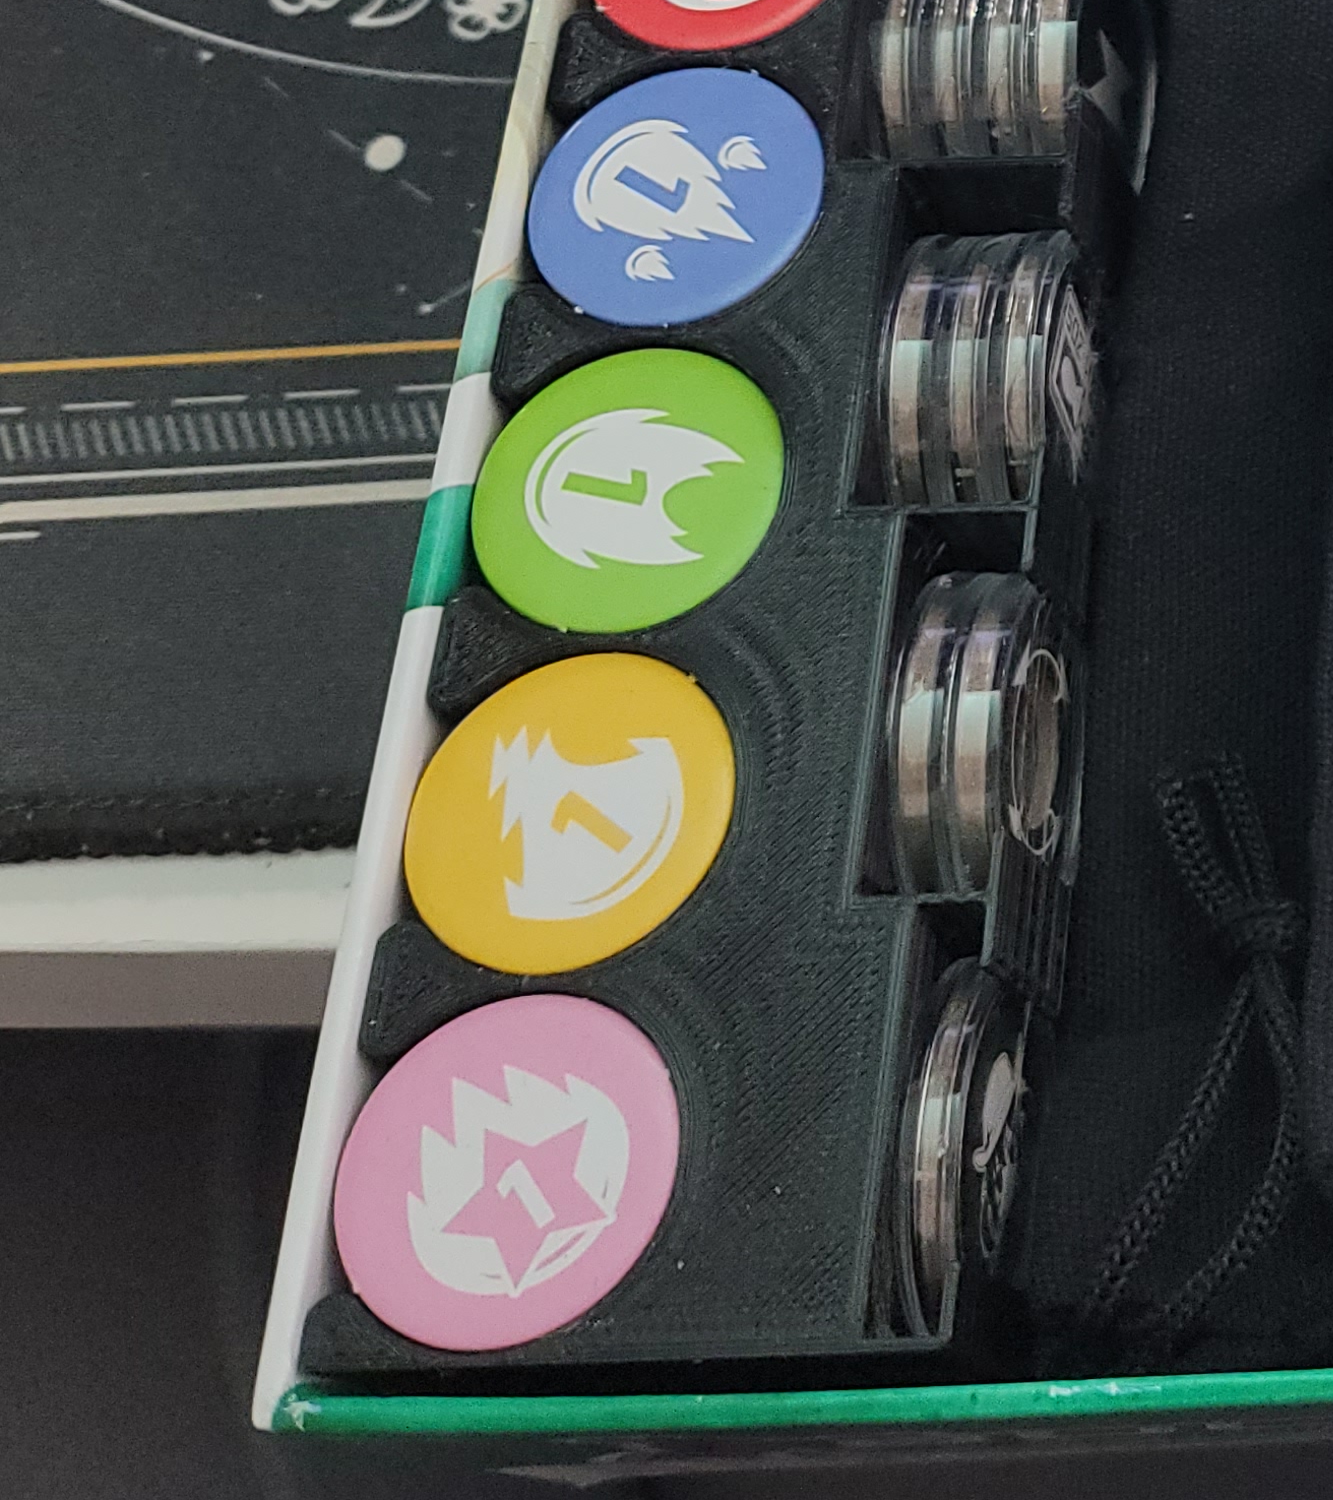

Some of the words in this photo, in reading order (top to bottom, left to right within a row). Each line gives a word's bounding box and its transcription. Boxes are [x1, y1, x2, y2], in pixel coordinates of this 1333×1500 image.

[614, 165, 691, 214] 1
[561, 468, 648, 506] 1
[550, 790, 633, 854] 1
[496, 1158, 556, 1229] 1
